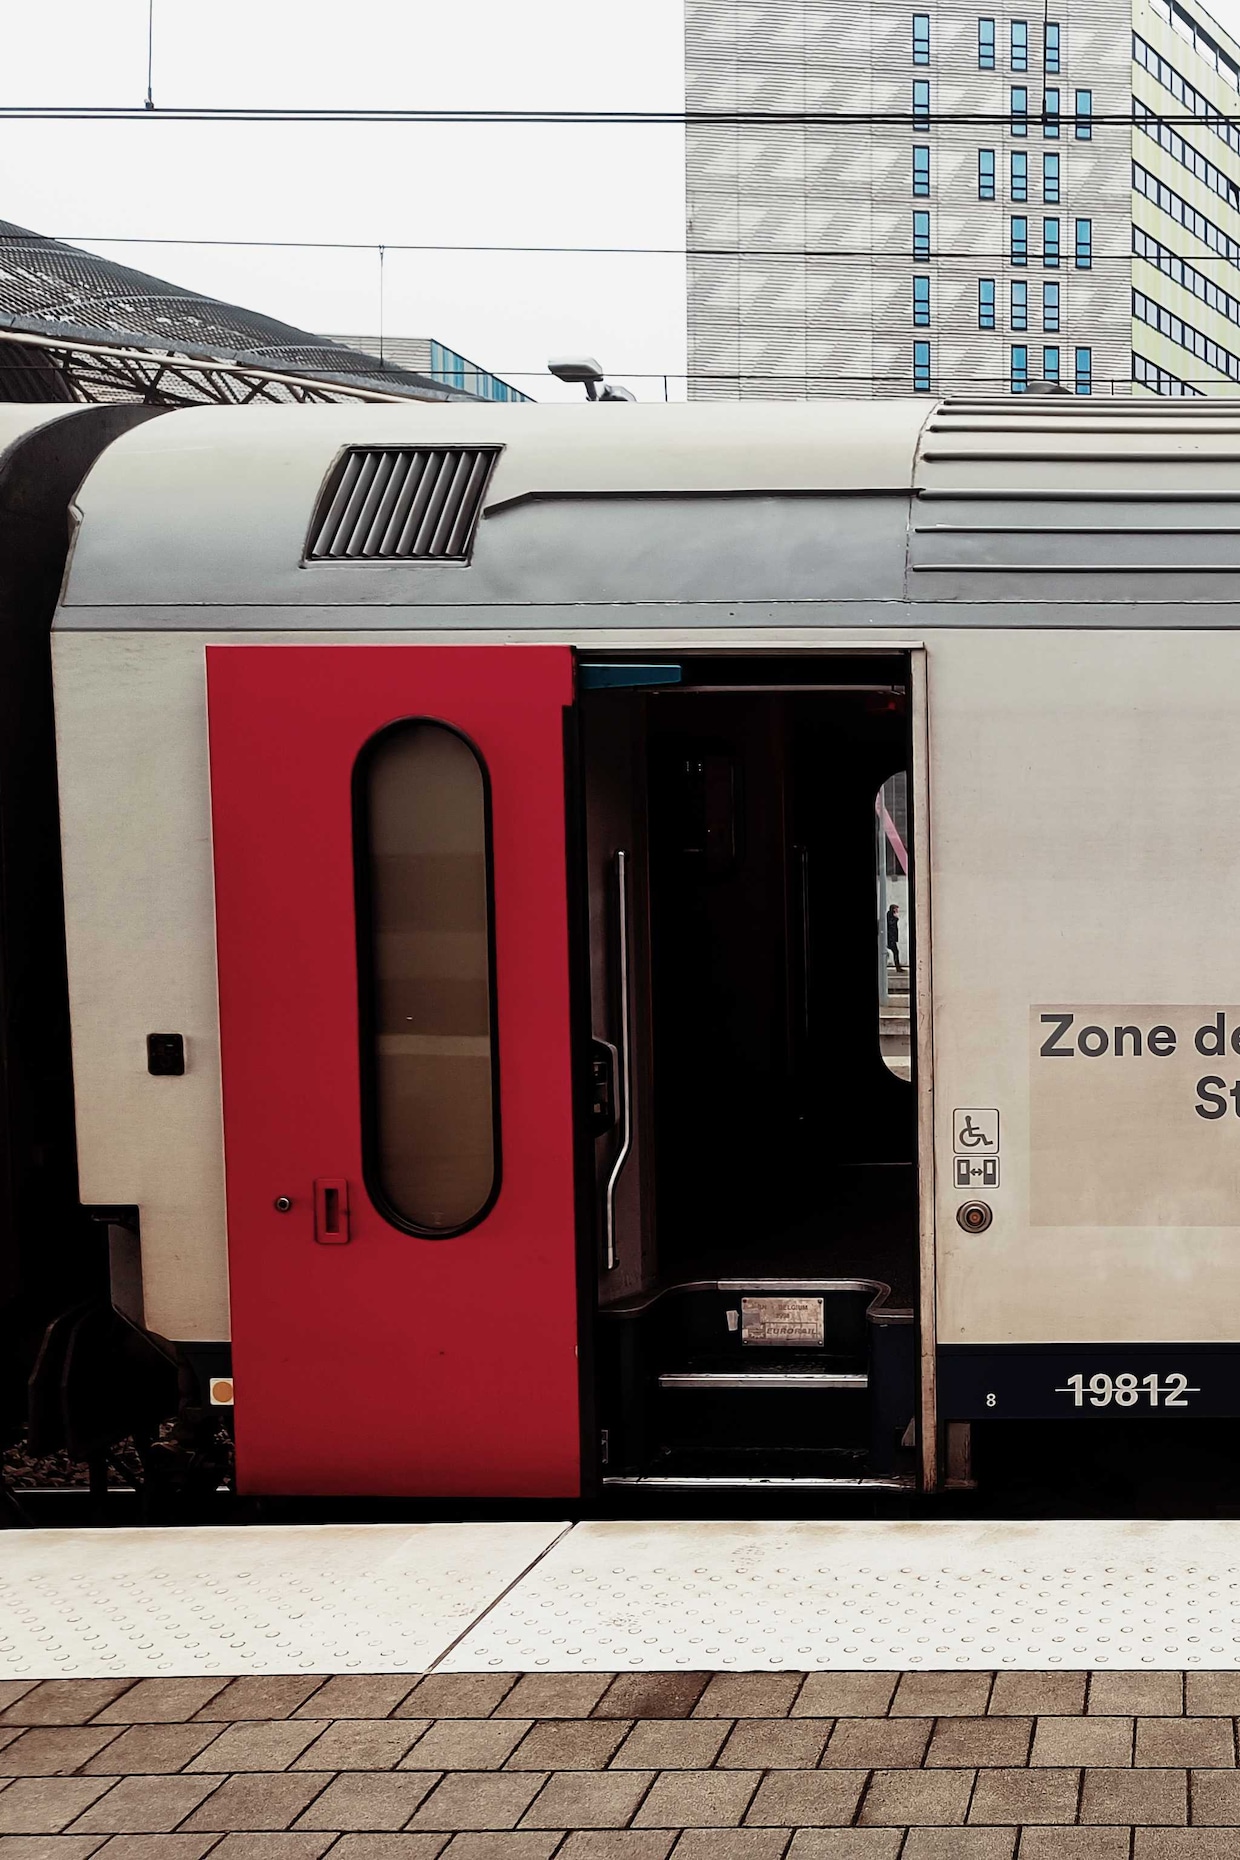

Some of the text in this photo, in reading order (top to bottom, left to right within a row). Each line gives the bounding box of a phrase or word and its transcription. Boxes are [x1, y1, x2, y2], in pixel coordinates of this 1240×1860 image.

[1041, 1014, 1176, 1057] Zone
[766, 1327, 817, 1335] EURORAIL
[987, 1394, 996, 1406] 8
[1067, 1374, 1188, 1406] 19812
